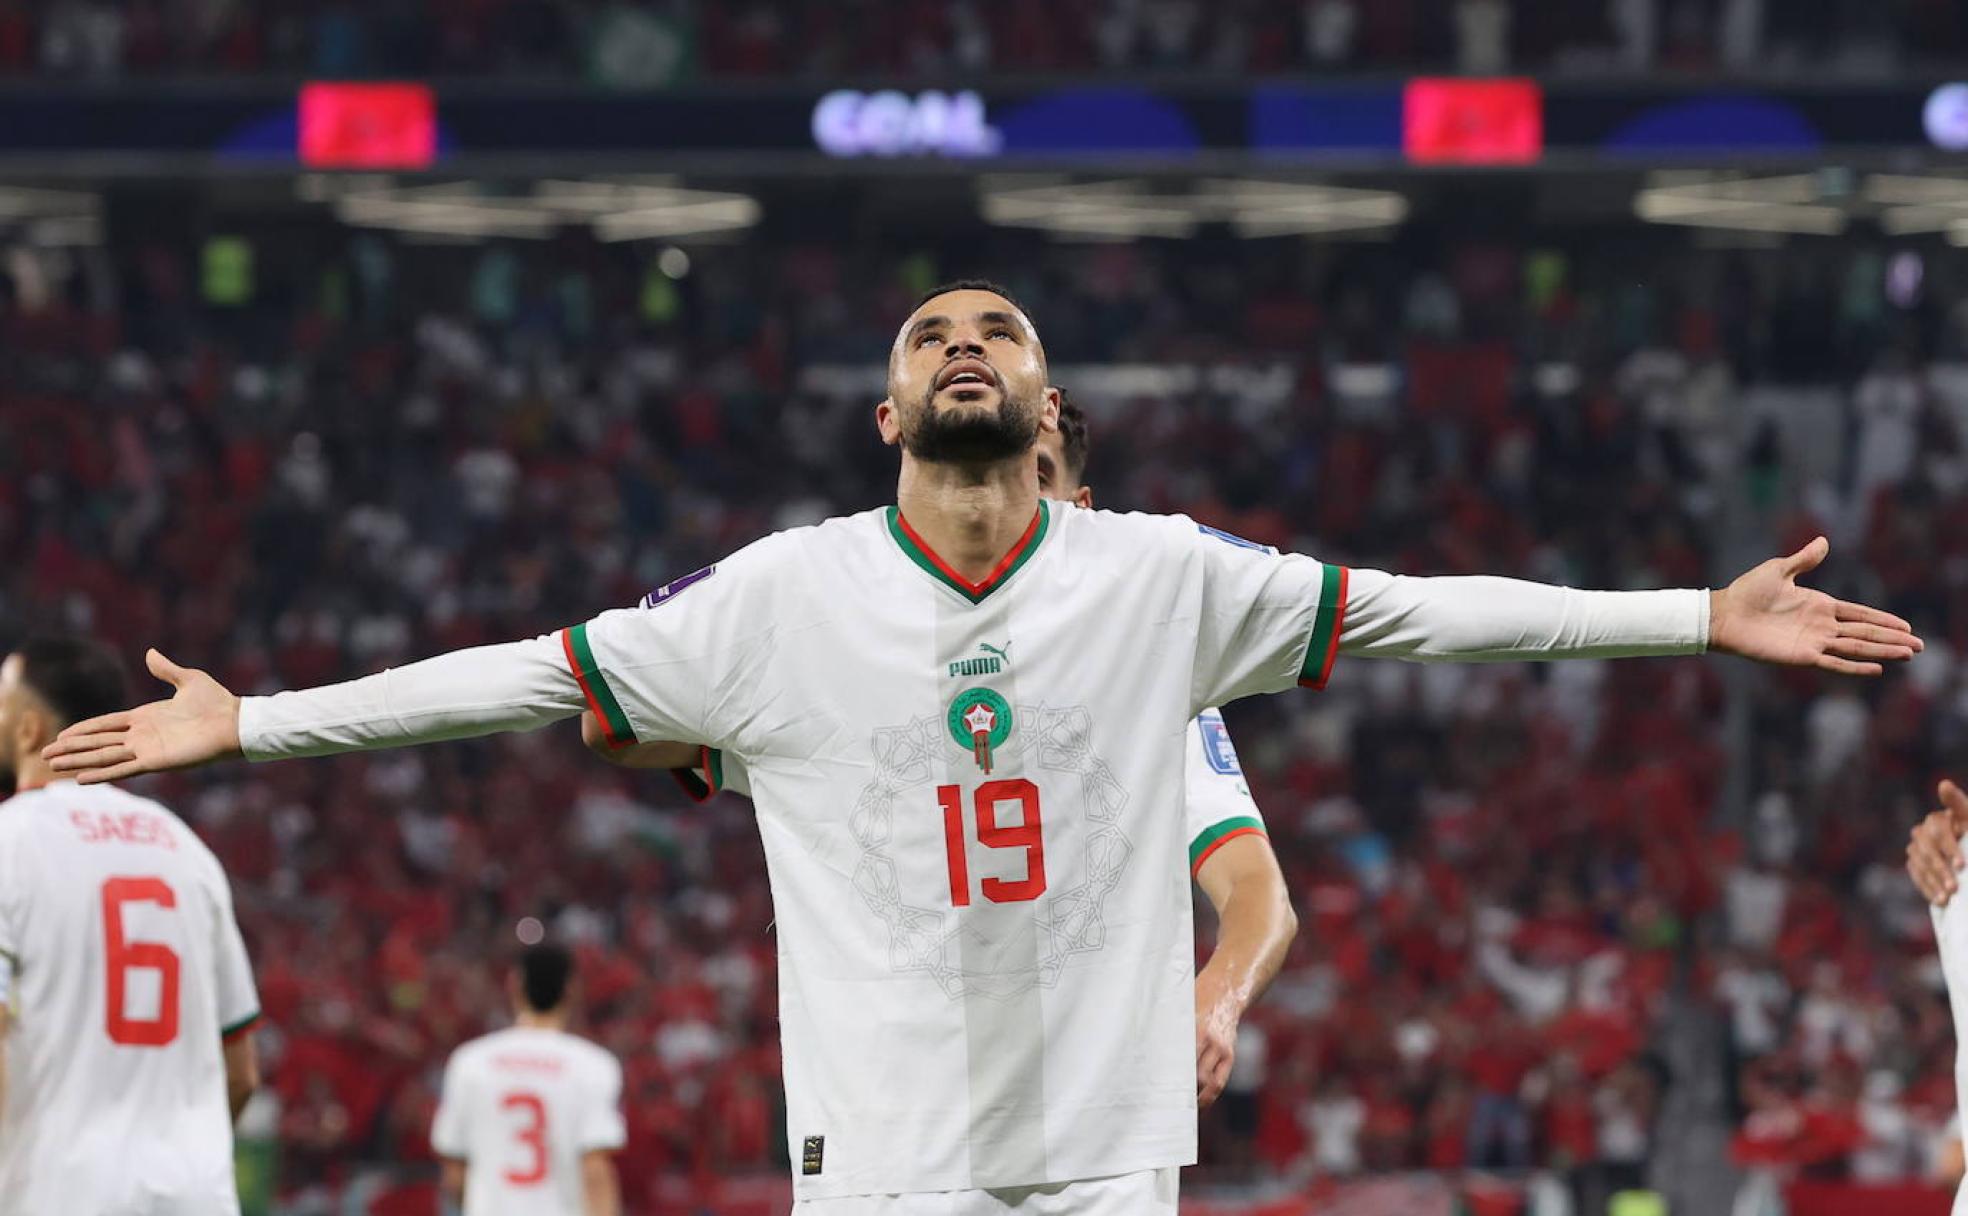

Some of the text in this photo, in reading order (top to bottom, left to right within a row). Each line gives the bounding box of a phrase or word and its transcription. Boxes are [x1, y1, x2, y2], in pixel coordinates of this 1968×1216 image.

[949, 657, 1001, 677] PUMA
[937, 779, 1047, 907] 19
[101, 876, 180, 1046] 6
[501, 1092, 548, 1187] 3
